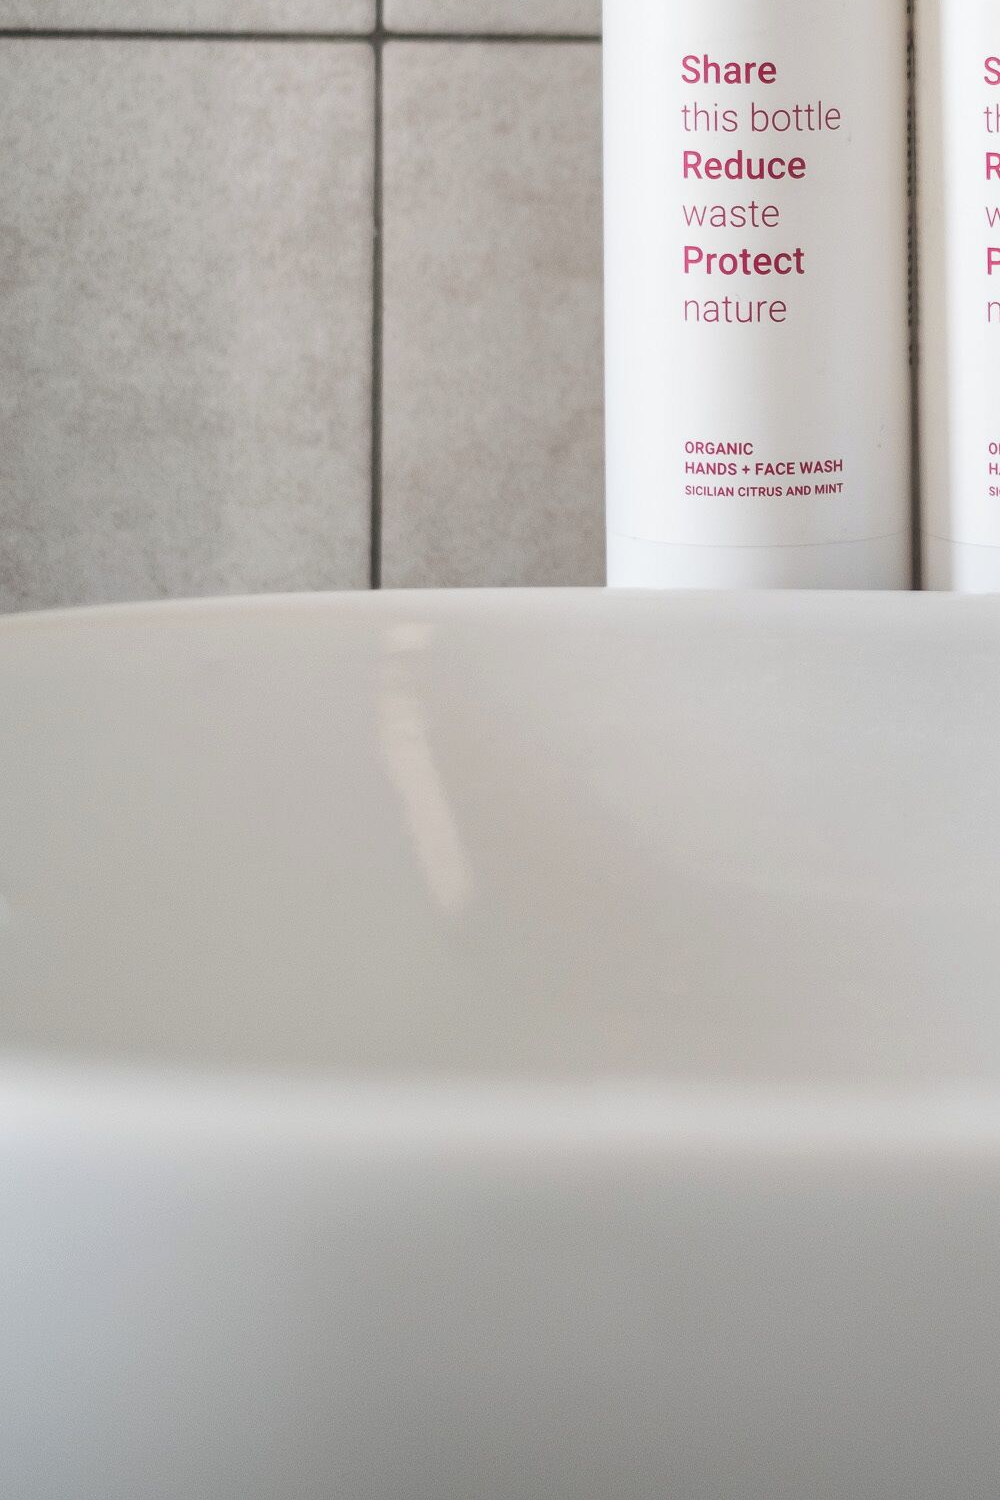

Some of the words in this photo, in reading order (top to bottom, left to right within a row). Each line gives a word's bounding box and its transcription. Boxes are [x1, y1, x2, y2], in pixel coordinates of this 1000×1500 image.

[681, 54, 777, 85] Share
[681, 103, 738, 133] this
[751, 101, 842, 132] bottle
[682, 149, 807, 180] Reduce
[682, 199, 780, 228] waste
[683, 245, 806, 276] Protect
[684, 296, 788, 324] nature
[684, 441, 754, 456] ORGANIC
[684, 461, 737, 476] HANDS
[742, 466, 750, 475] +
[754, 462, 795, 476] FACE
[799, 459, 844, 474] WASH
[684, 485, 734, 497] SICILIAN
[737, 486, 783, 497] CITRUS
[786, 485, 812, 496] AND
[815, 482, 844, 495] MINT
